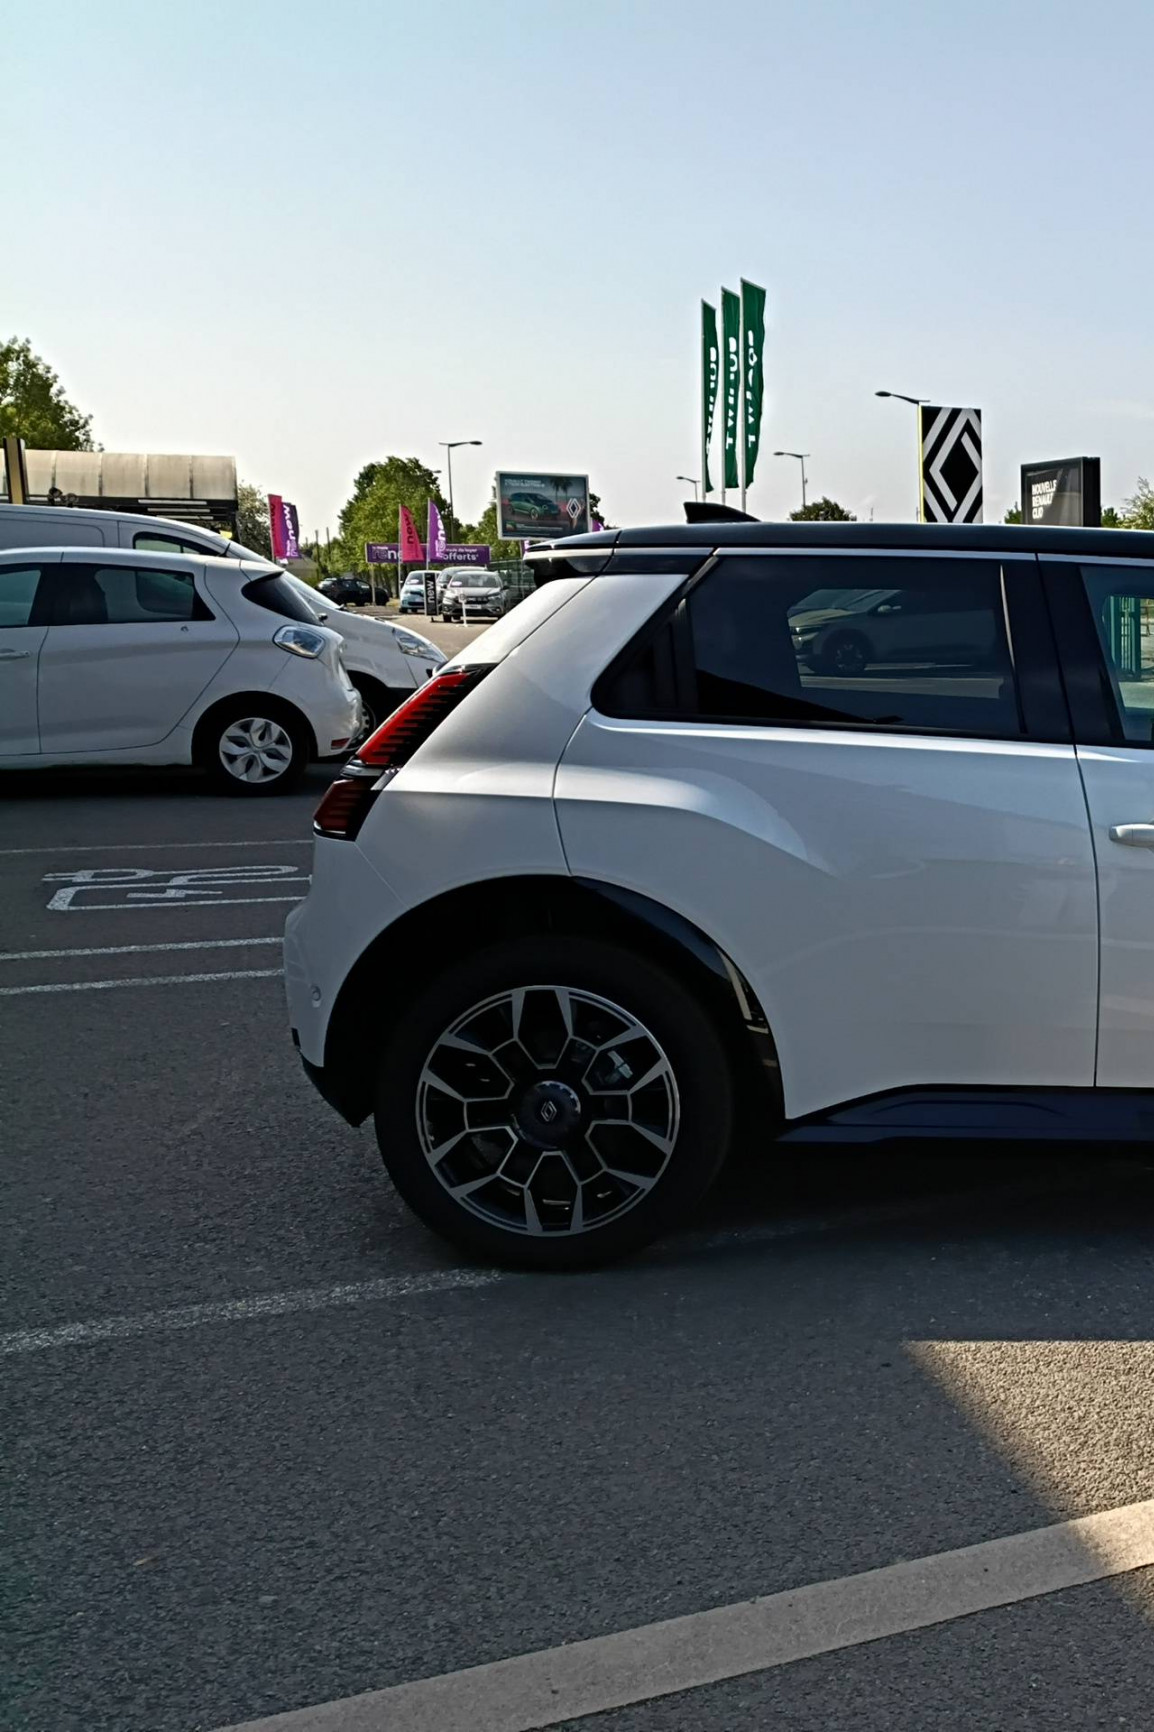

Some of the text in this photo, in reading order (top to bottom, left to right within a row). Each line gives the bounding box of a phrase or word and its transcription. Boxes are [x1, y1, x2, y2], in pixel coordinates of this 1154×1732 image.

[1031, 479, 1057, 495] NOUVELLE
[1031, 492, 1054, 507] RENAULT
[1031, 506, 1044, 519] CLIO
